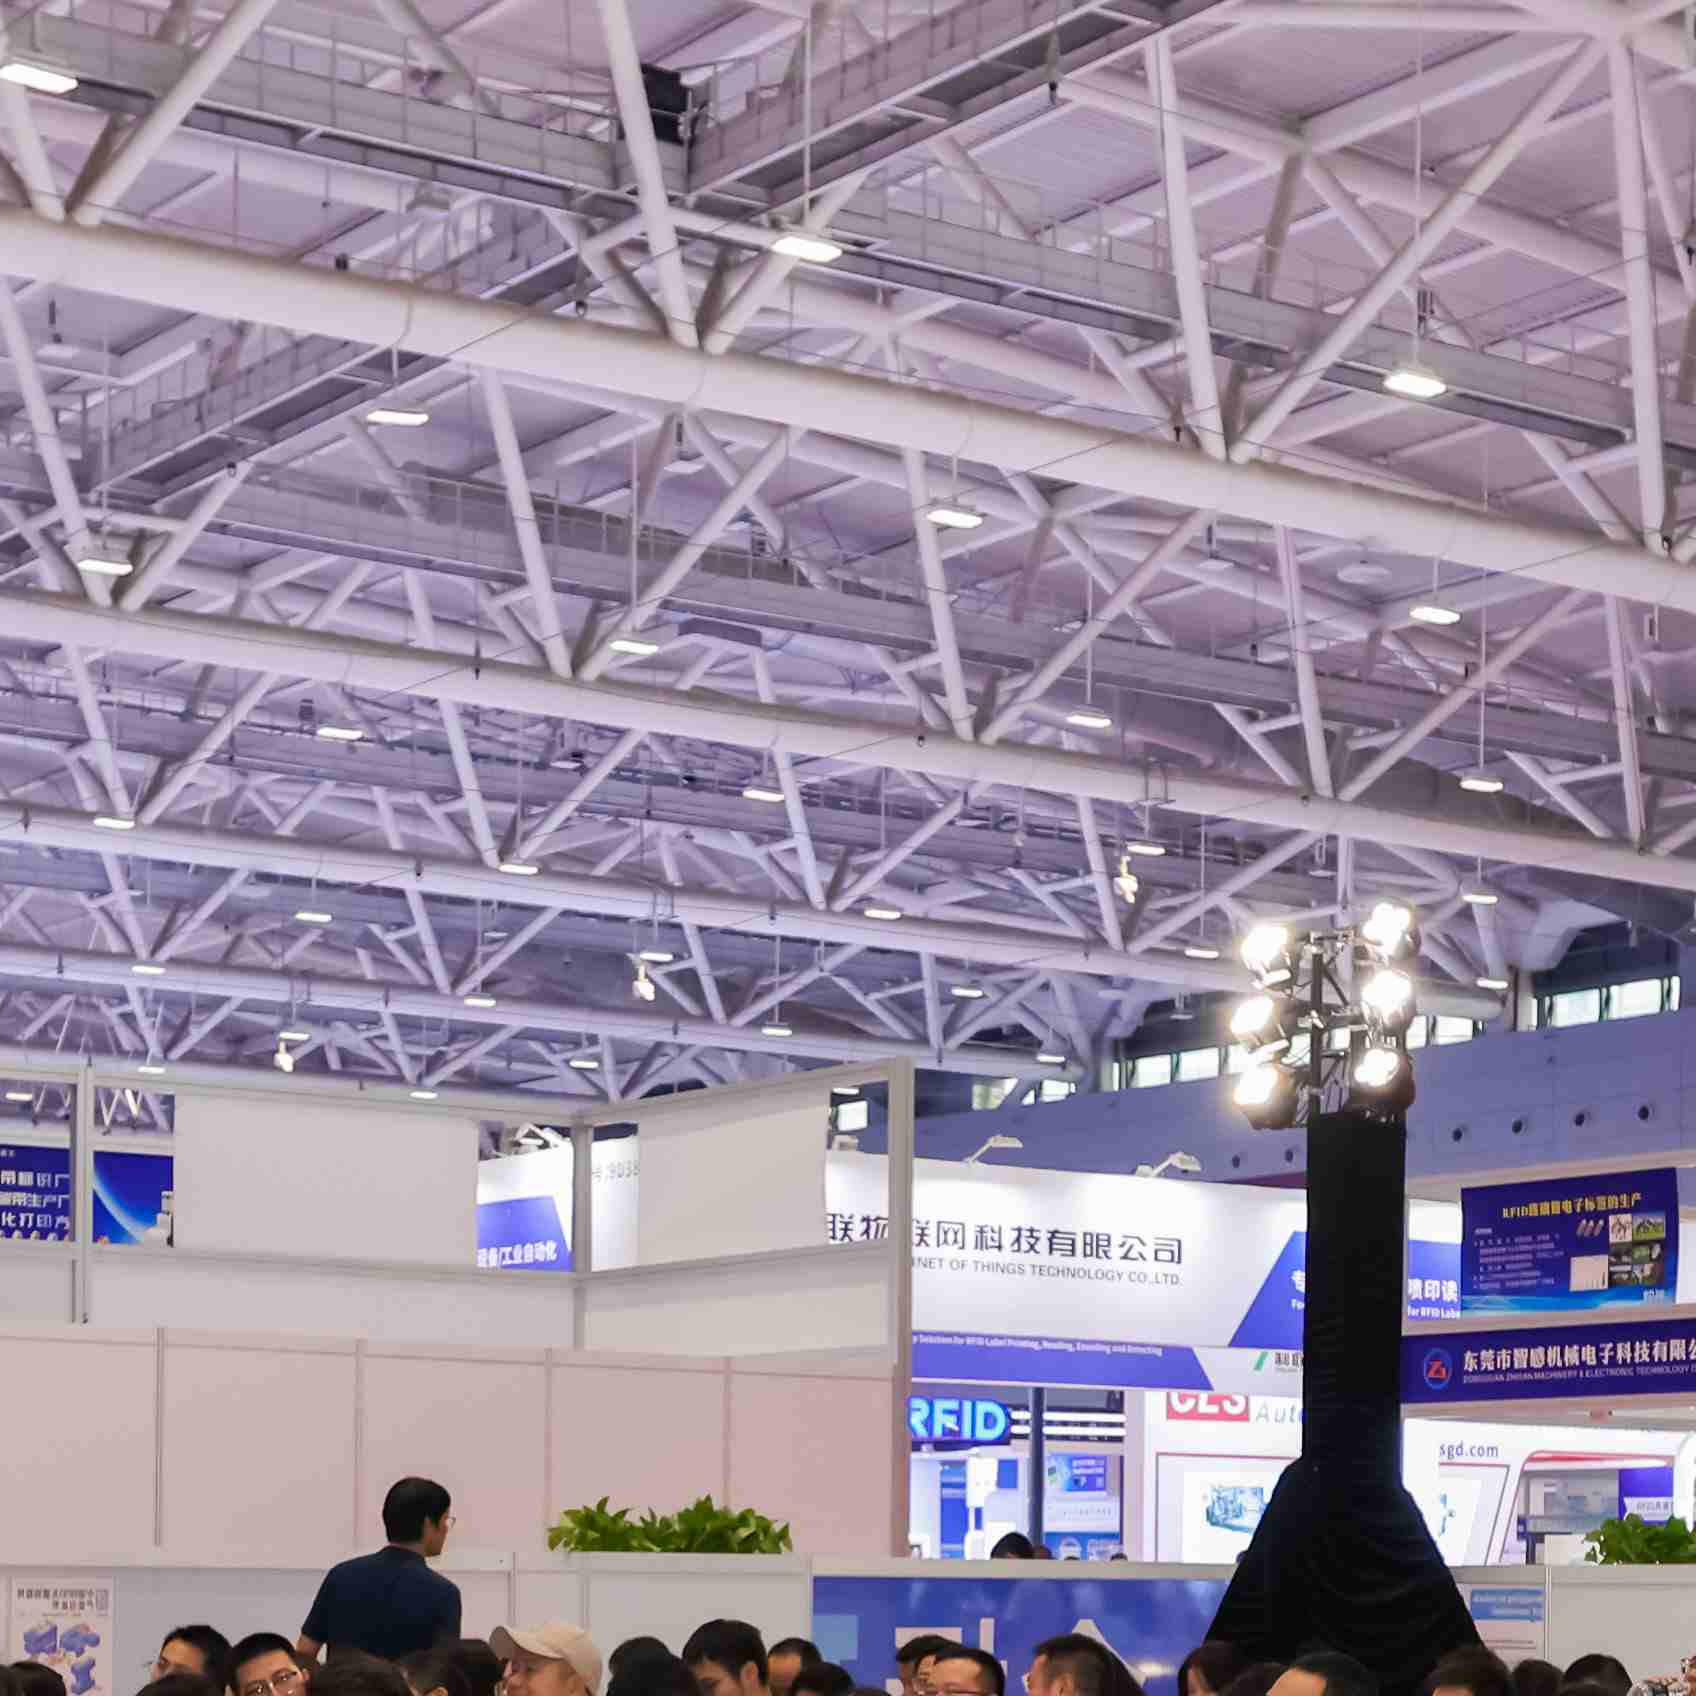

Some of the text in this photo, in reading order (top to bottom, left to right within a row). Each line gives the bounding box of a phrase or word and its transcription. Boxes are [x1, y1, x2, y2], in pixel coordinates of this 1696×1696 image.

[949, 1260, 968, 1272] OF
[973, 1260, 1026, 1276] THINGS
[1031, 1263, 1123, 1283] TECHNOLOGY
[909, 1398, 1007, 1441] RFID
